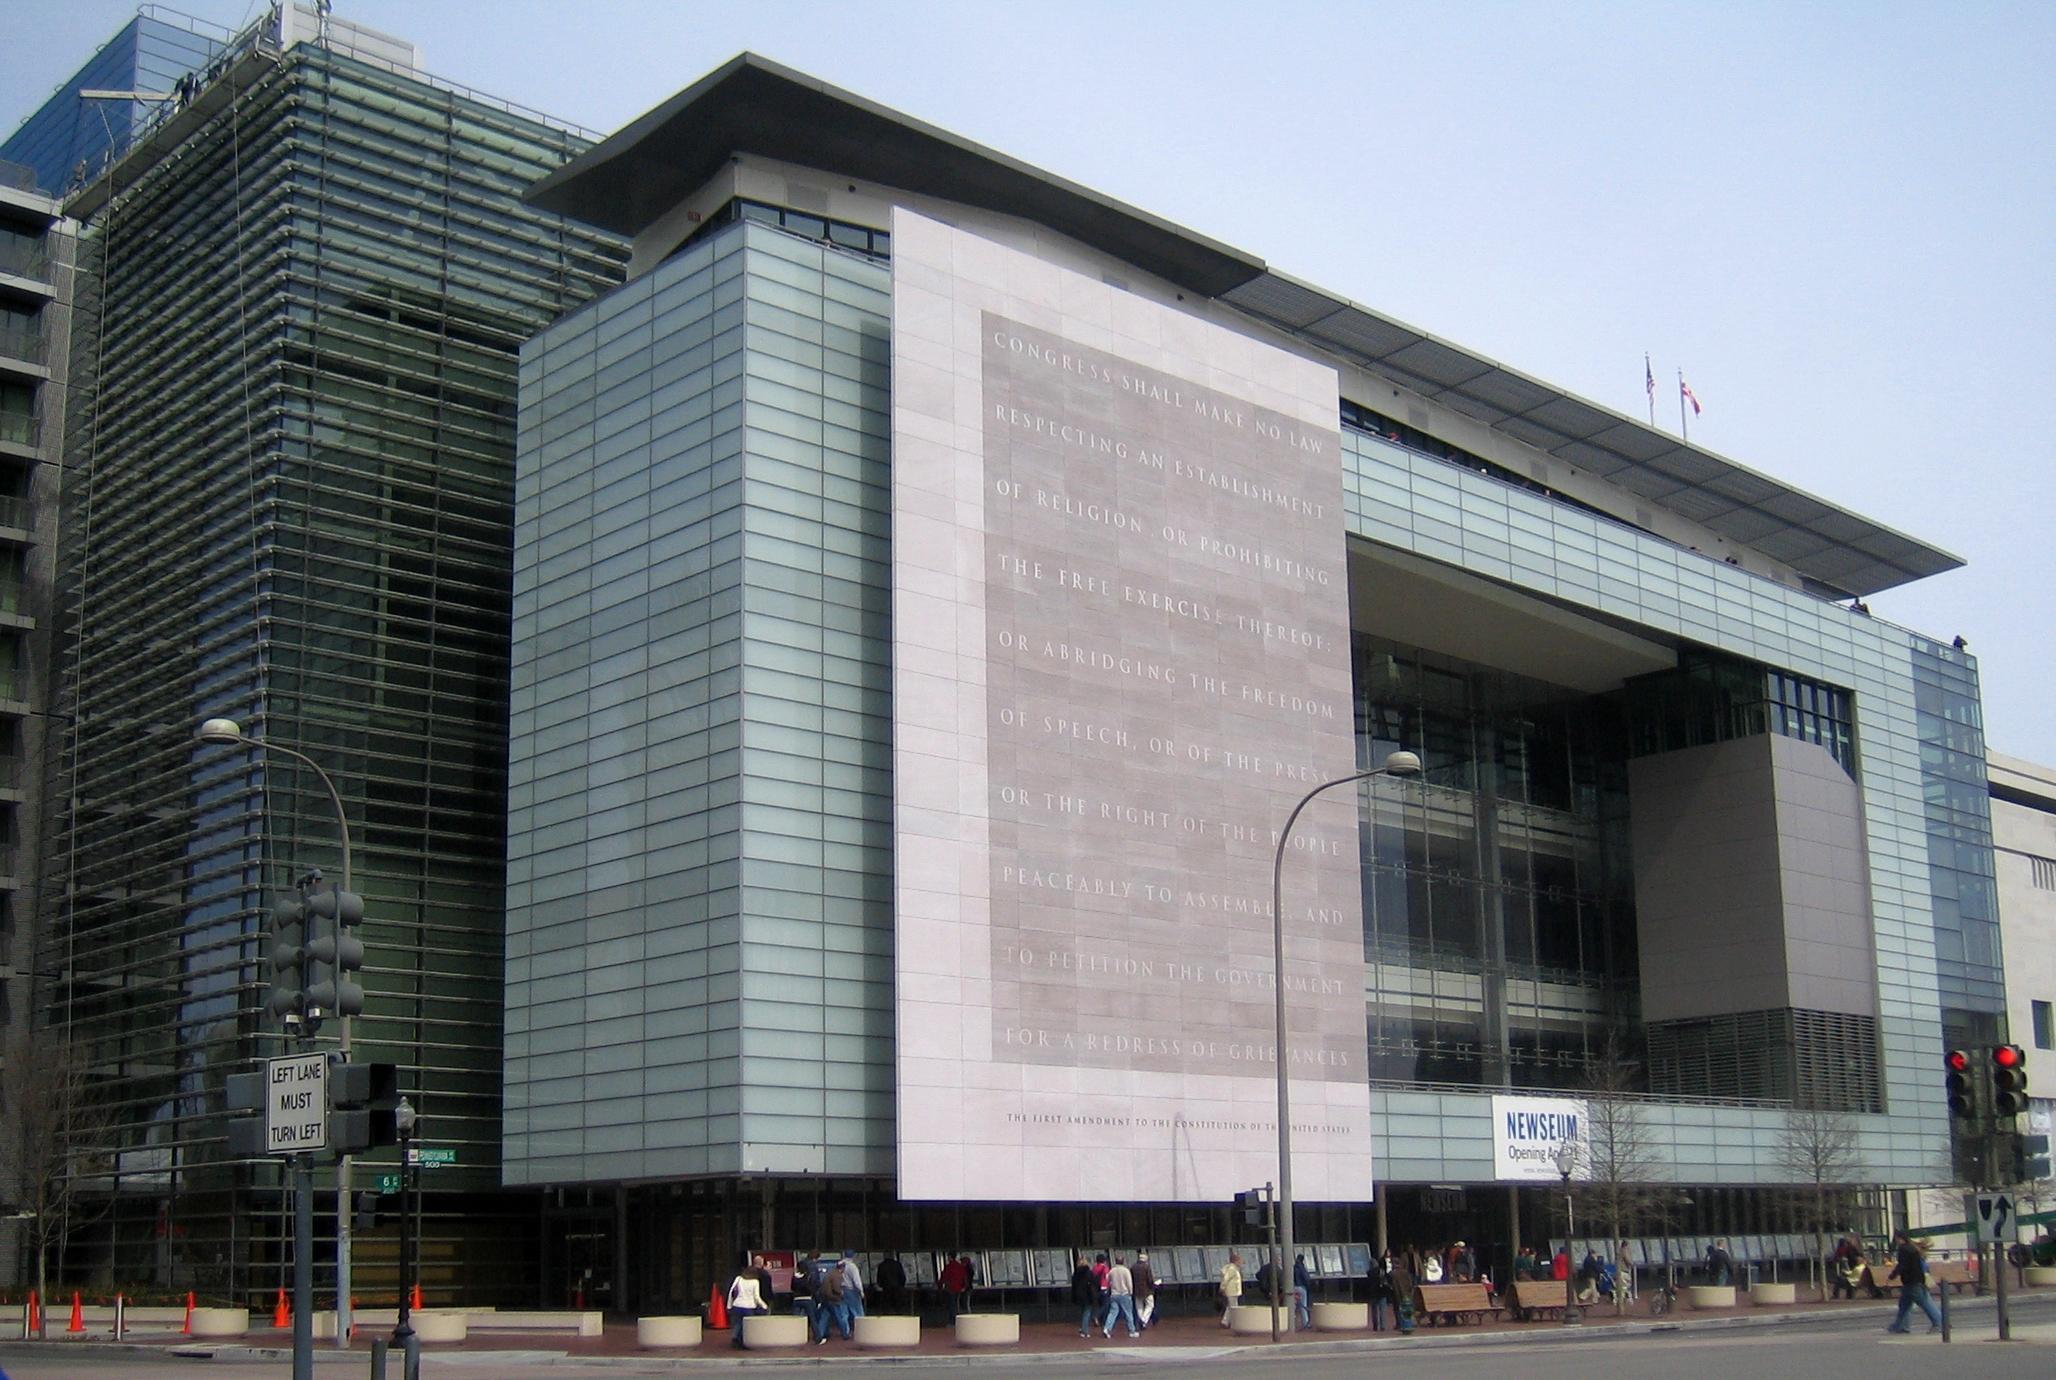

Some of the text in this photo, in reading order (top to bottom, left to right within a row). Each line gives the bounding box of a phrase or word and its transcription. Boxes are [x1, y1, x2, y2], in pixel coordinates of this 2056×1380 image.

[994, 331, 1323, 454] CONGRESS SHALL MAKE NO LAW
[995, 404, 1324, 519] RESPECTING AN ESTABLISHMENT
[996, 479, 1023, 499] OF
[1162, 526, 1189, 546] OR
[1200, 536, 1328, 585] PROHIBITING
[998, 553, 1043, 580] THE
[1058, 569, 1110, 596] FREE
[1125, 586, 1223, 625] EXERCISE
[999, 631, 1334, 720] OR ABRIDGING THE FREEDOM
[1000, 708, 1028, 728] OF
[1150, 737, 1176, 756] OR
[1188, 745, 1211, 763] OF
[1224, 751, 1261, 773] THE
[1001, 786, 1030, 806] OR
[1043, 792, 1088, 816] THE
[1101, 803, 1170, 829] RIGHT
[1183, 816, 1207, 834] OF
[1220, 823, 1257, 843] THE
[1003, 866, 1132, 898] PEACEABLY
[1145, 884, 1172, 903] TO
[1306, 908, 1344, 925] AND
[1006, 946, 1033, 965] TO
[1049, 951, 1153, 976] PETITION
[1166, 962, 1205, 983] THE
[1006, 1027, 1348, 1066] FOR A REDRESS OF GRIEANCES
[272, 1063, 321, 1084] LEFT LANE
[281, 1092, 312, 1111] MUST
[1007, 1113, 1027, 1122] THE
[1033, 1114, 1062, 1124] FIRST
[1067, 1116, 1130, 1127] AMENDMENT
[1135, 1118, 1148, 1127] TO
[272, 1123, 321, 1142] TURN LEFT
[1507, 1112, 1578, 1141] NEWSEUM
[1508, 1145, 1546, 1163] Opening
